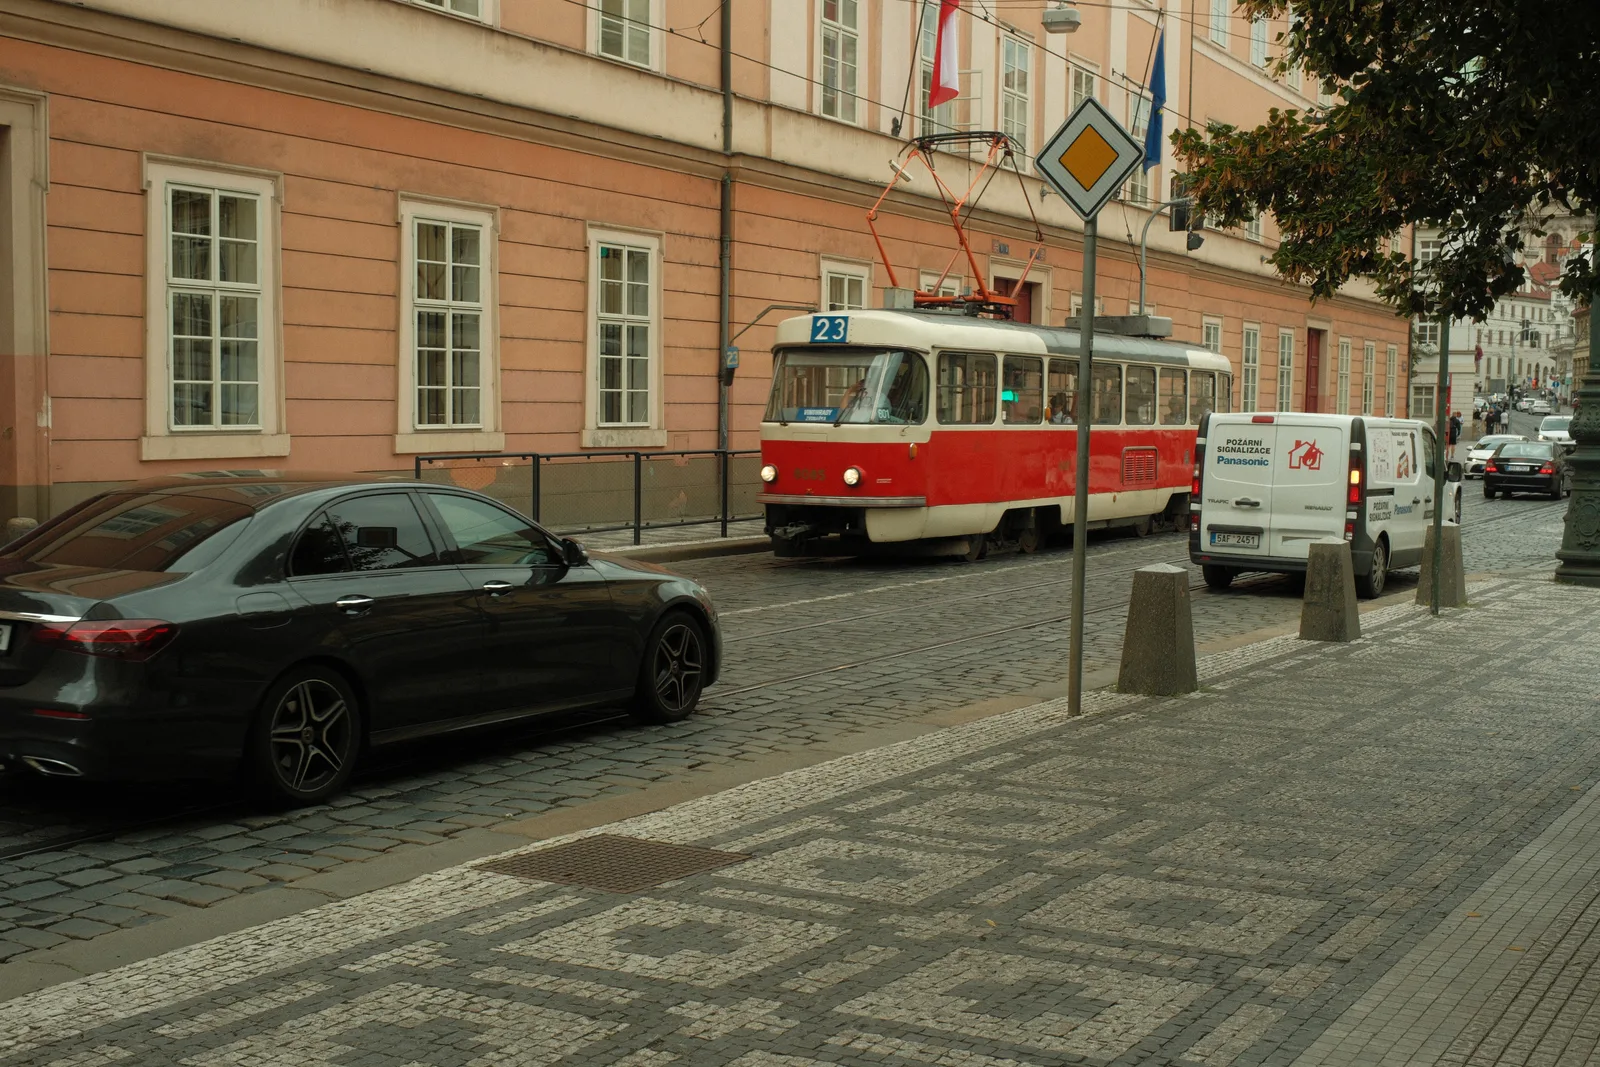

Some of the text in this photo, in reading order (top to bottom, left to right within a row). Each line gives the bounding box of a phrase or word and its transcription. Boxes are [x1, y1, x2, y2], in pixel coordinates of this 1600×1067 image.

[814, 318, 845, 340] 23
[727, 351, 738, 365] 23
[1217, 446, 1271, 454] SIGNALIZACE
[1217, 455, 1269, 466] Panasonic
[1236, 536, 1255, 544] 2451
